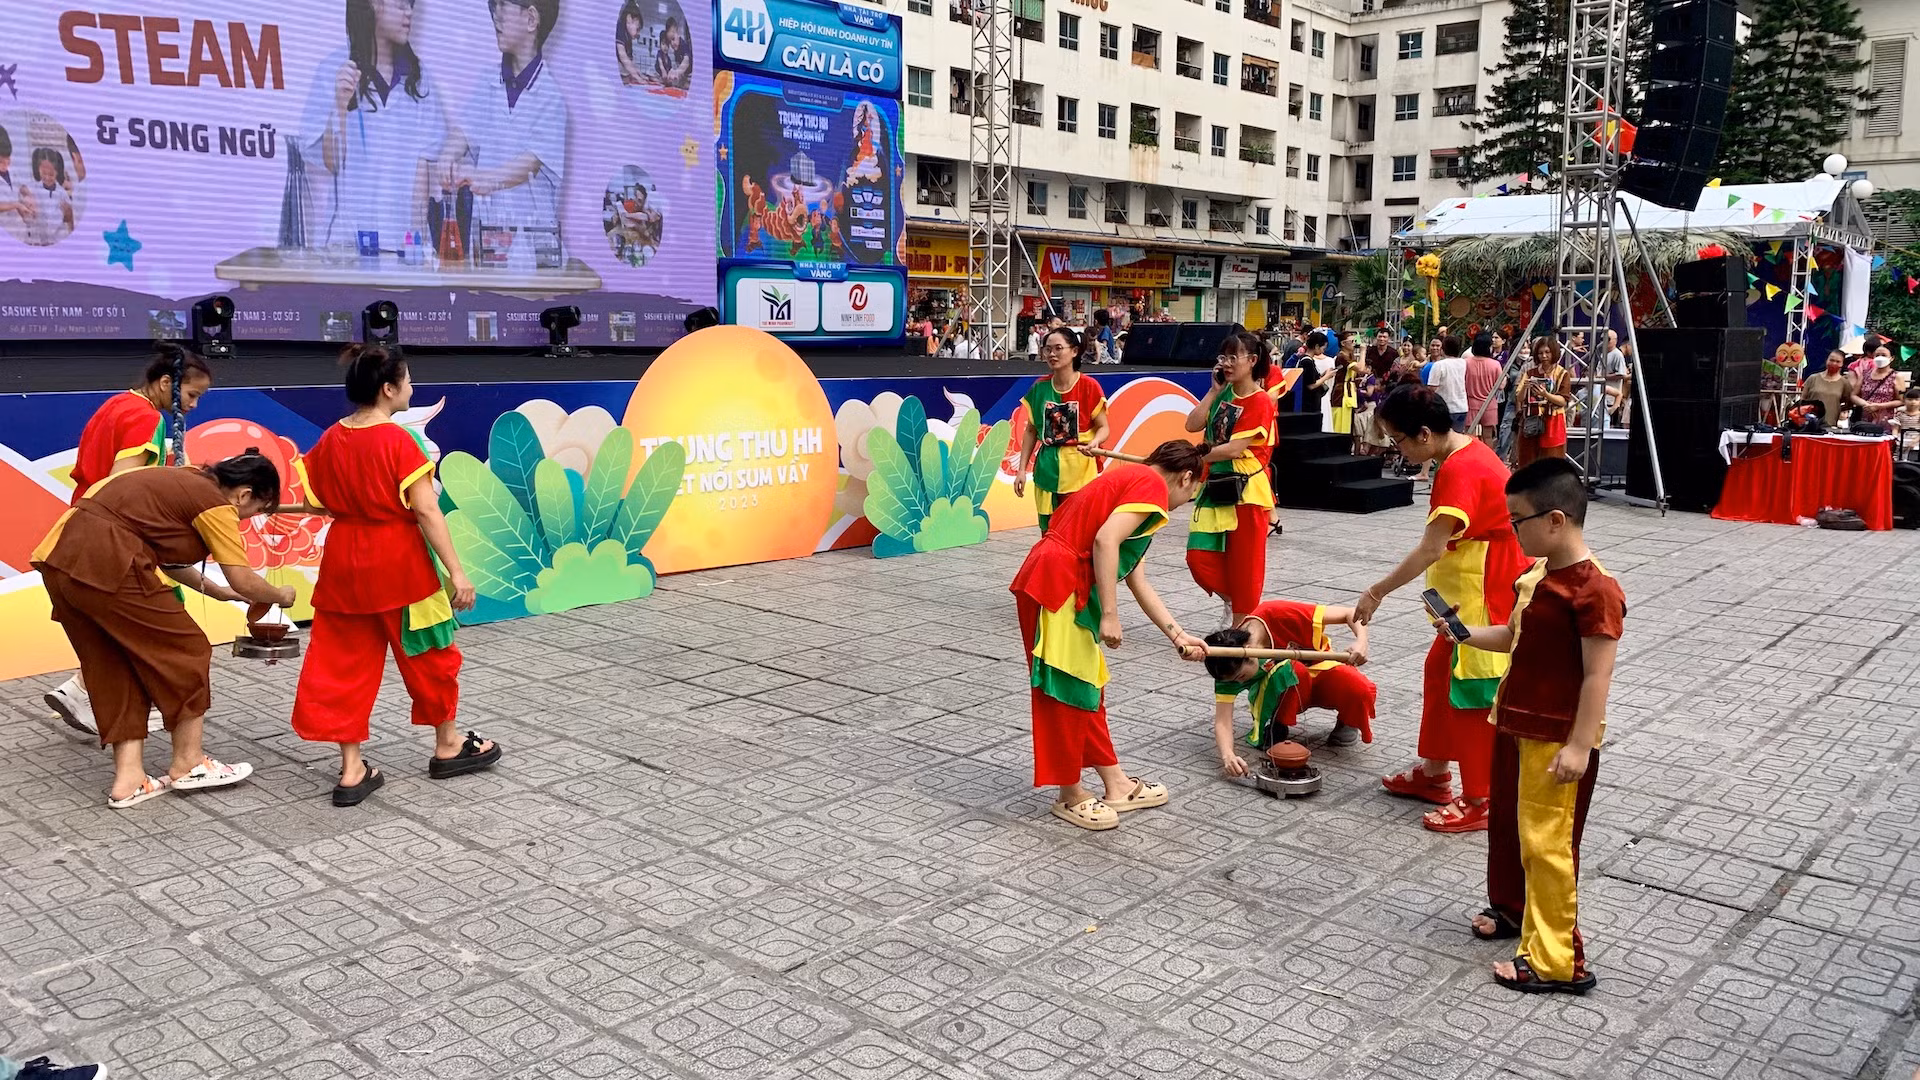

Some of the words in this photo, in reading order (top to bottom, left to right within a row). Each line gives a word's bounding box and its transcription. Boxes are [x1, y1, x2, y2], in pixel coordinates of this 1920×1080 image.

[724, 7, 766, 45] 4H
[853, 14, 875, 26] VÀNG
[778, 17, 800, 32] HIỆP
[800, 22, 817, 34] HỘI
[817, 25, 838, 37] KINH
[838, 29, 868, 45] DOANH
[868, 36, 881, 46] UY
[880, 37, 893, 50] TÍN
[58, 10, 285, 90] STEAM
[781, 41, 824, 74] CẦN
[828, 52, 854, 79] LÀ
[857, 58, 885, 84] CÓ
[96, 114, 119, 145] &
[128, 117, 210, 153] SONG
[218, 123, 276, 159] NGỮ
[810, 269, 832, 278] VÀNG
[1, 305, 37, 317] SASUKE
[40, 304, 59, 319] VIỆT
[62, 307, 83, 317] NAM
[92, 306, 104, 317] CƠ
[106, 304, 118, 317] SỞ
[121, 307, 127, 318] 1
[243, 311, 260, 321] NAM
[261, 311, 266, 321] 3
[272, 310, 282, 321] CƠ
[284, 309, 294, 321] SỞ
[295, 311, 300, 321] 3
[403, 311, 418, 321] NAM
[506, 312, 528, 321] SASUKE
[644, 312, 663, 321] SASUKE
[675, 312, 687, 321] NAM
[863, 314, 875, 323] FOOD
[640, 431, 733, 466] TUNG
[738, 429, 788, 460] THU
[792, 427, 823, 455] HH
[699, 462, 733, 493] NỐI
[736, 465, 773, 491] SUM
[778, 456, 810, 485] VẦY
[719, 497, 759, 511] 2023
